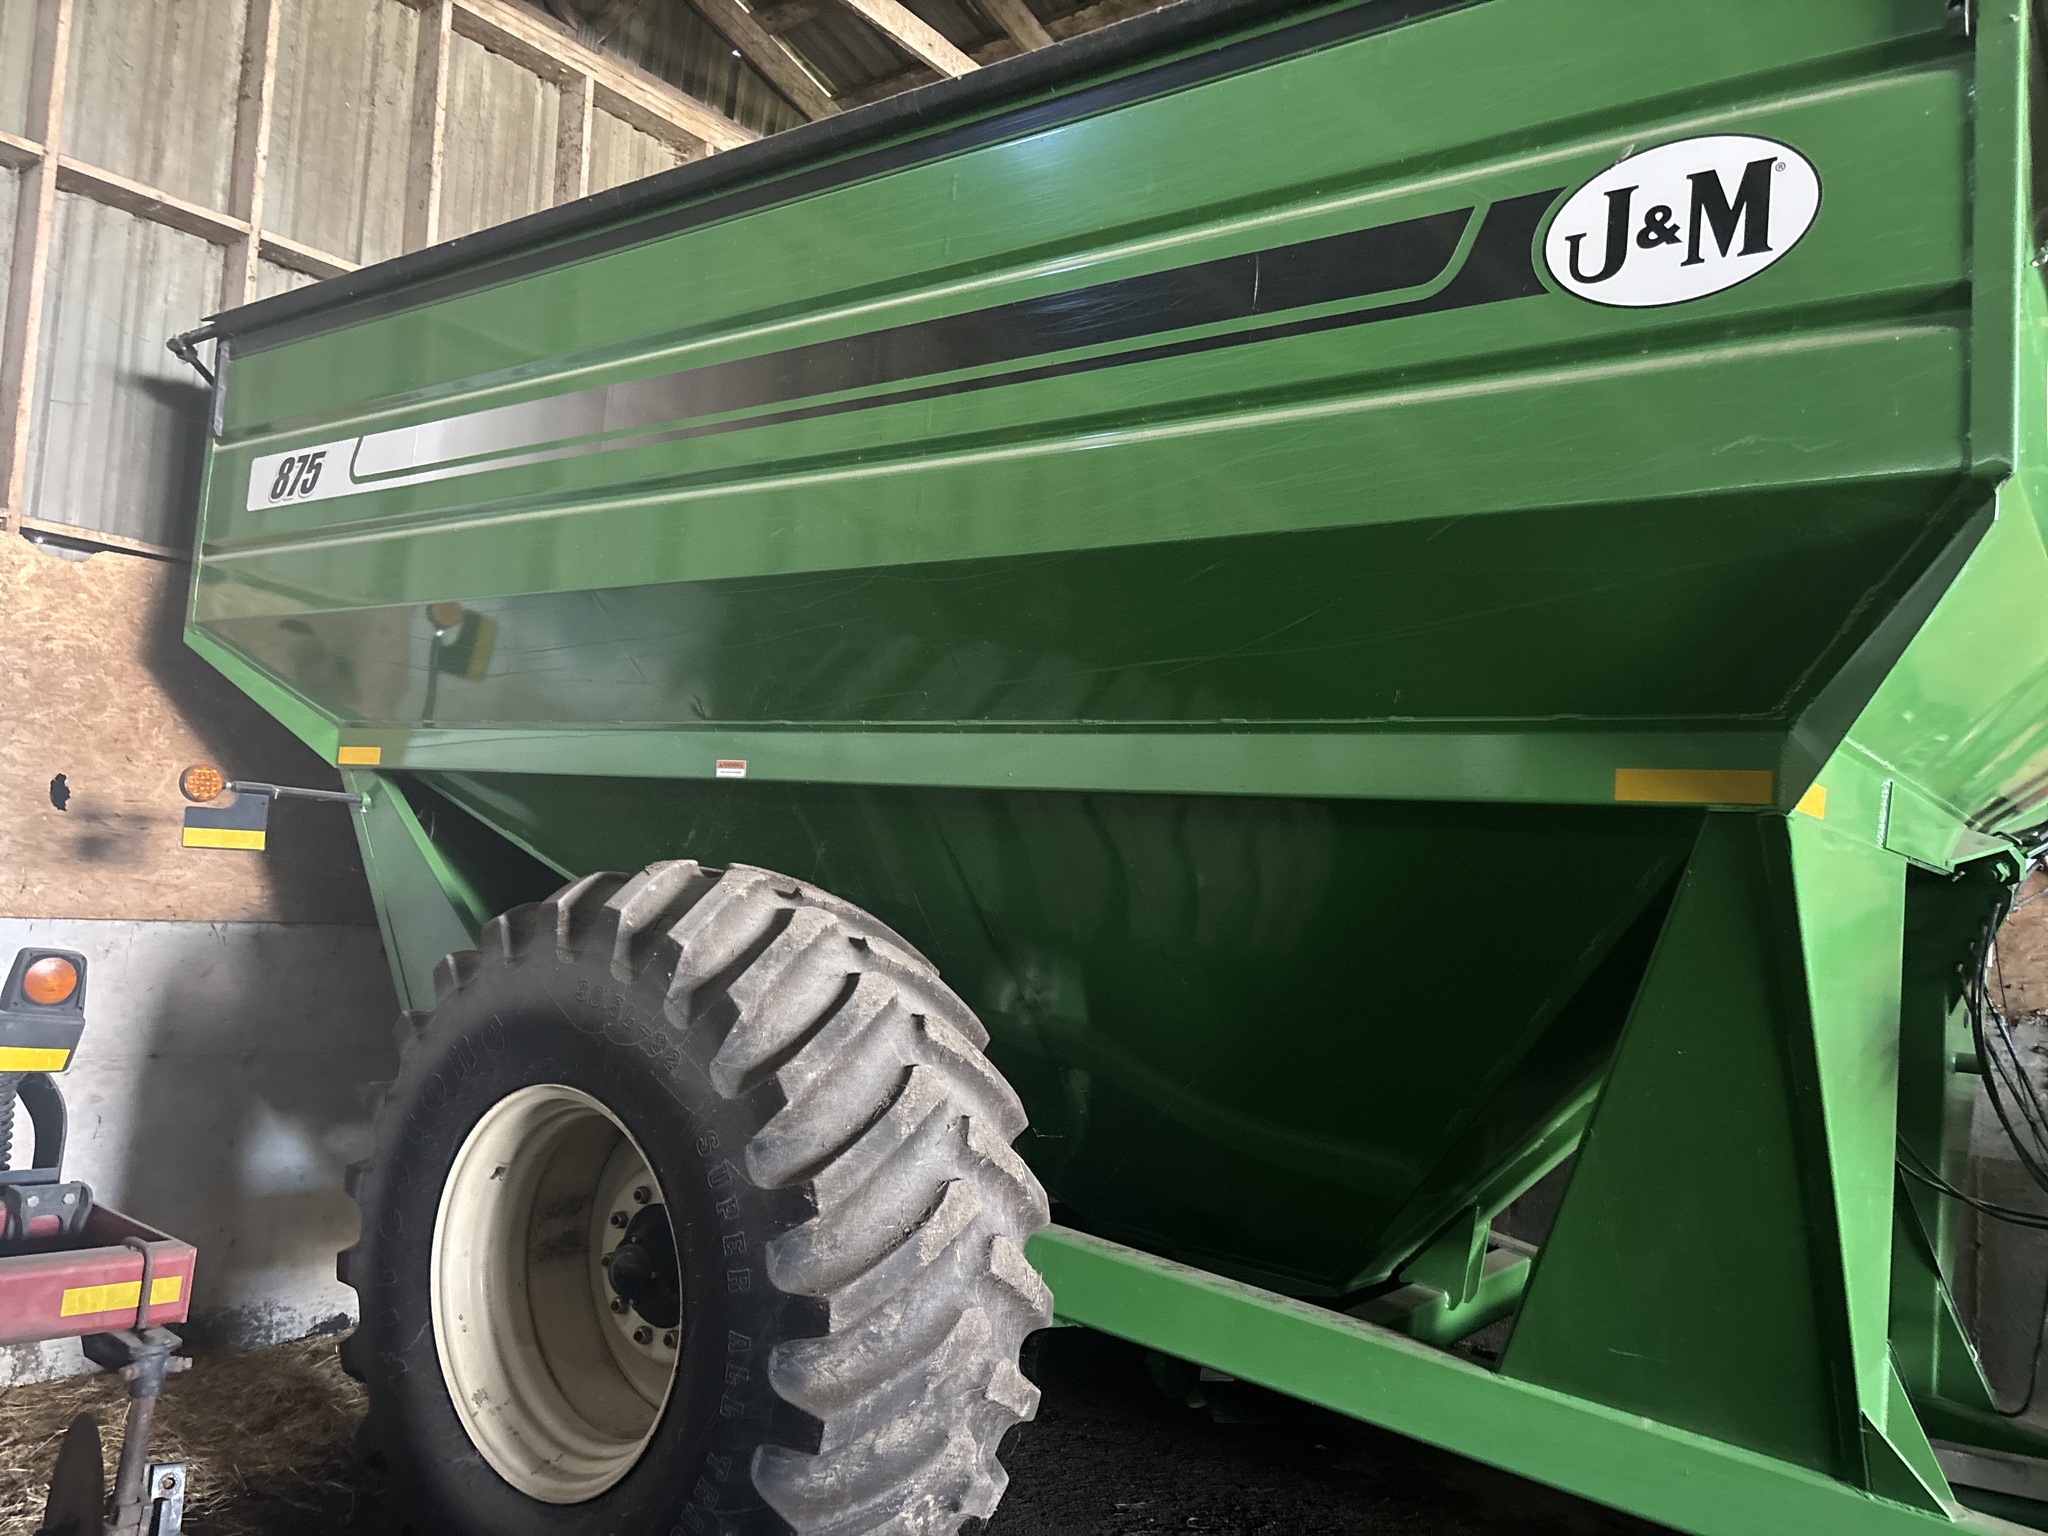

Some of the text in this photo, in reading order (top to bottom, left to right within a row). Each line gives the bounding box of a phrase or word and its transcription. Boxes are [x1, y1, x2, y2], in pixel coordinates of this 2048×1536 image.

[1565, 157, 1778, 285] J&M
[269, 450, 328, 502] 875
[696, 1129, 751, 1295] SUPER
[719, 1329, 751, 1418] ALL
